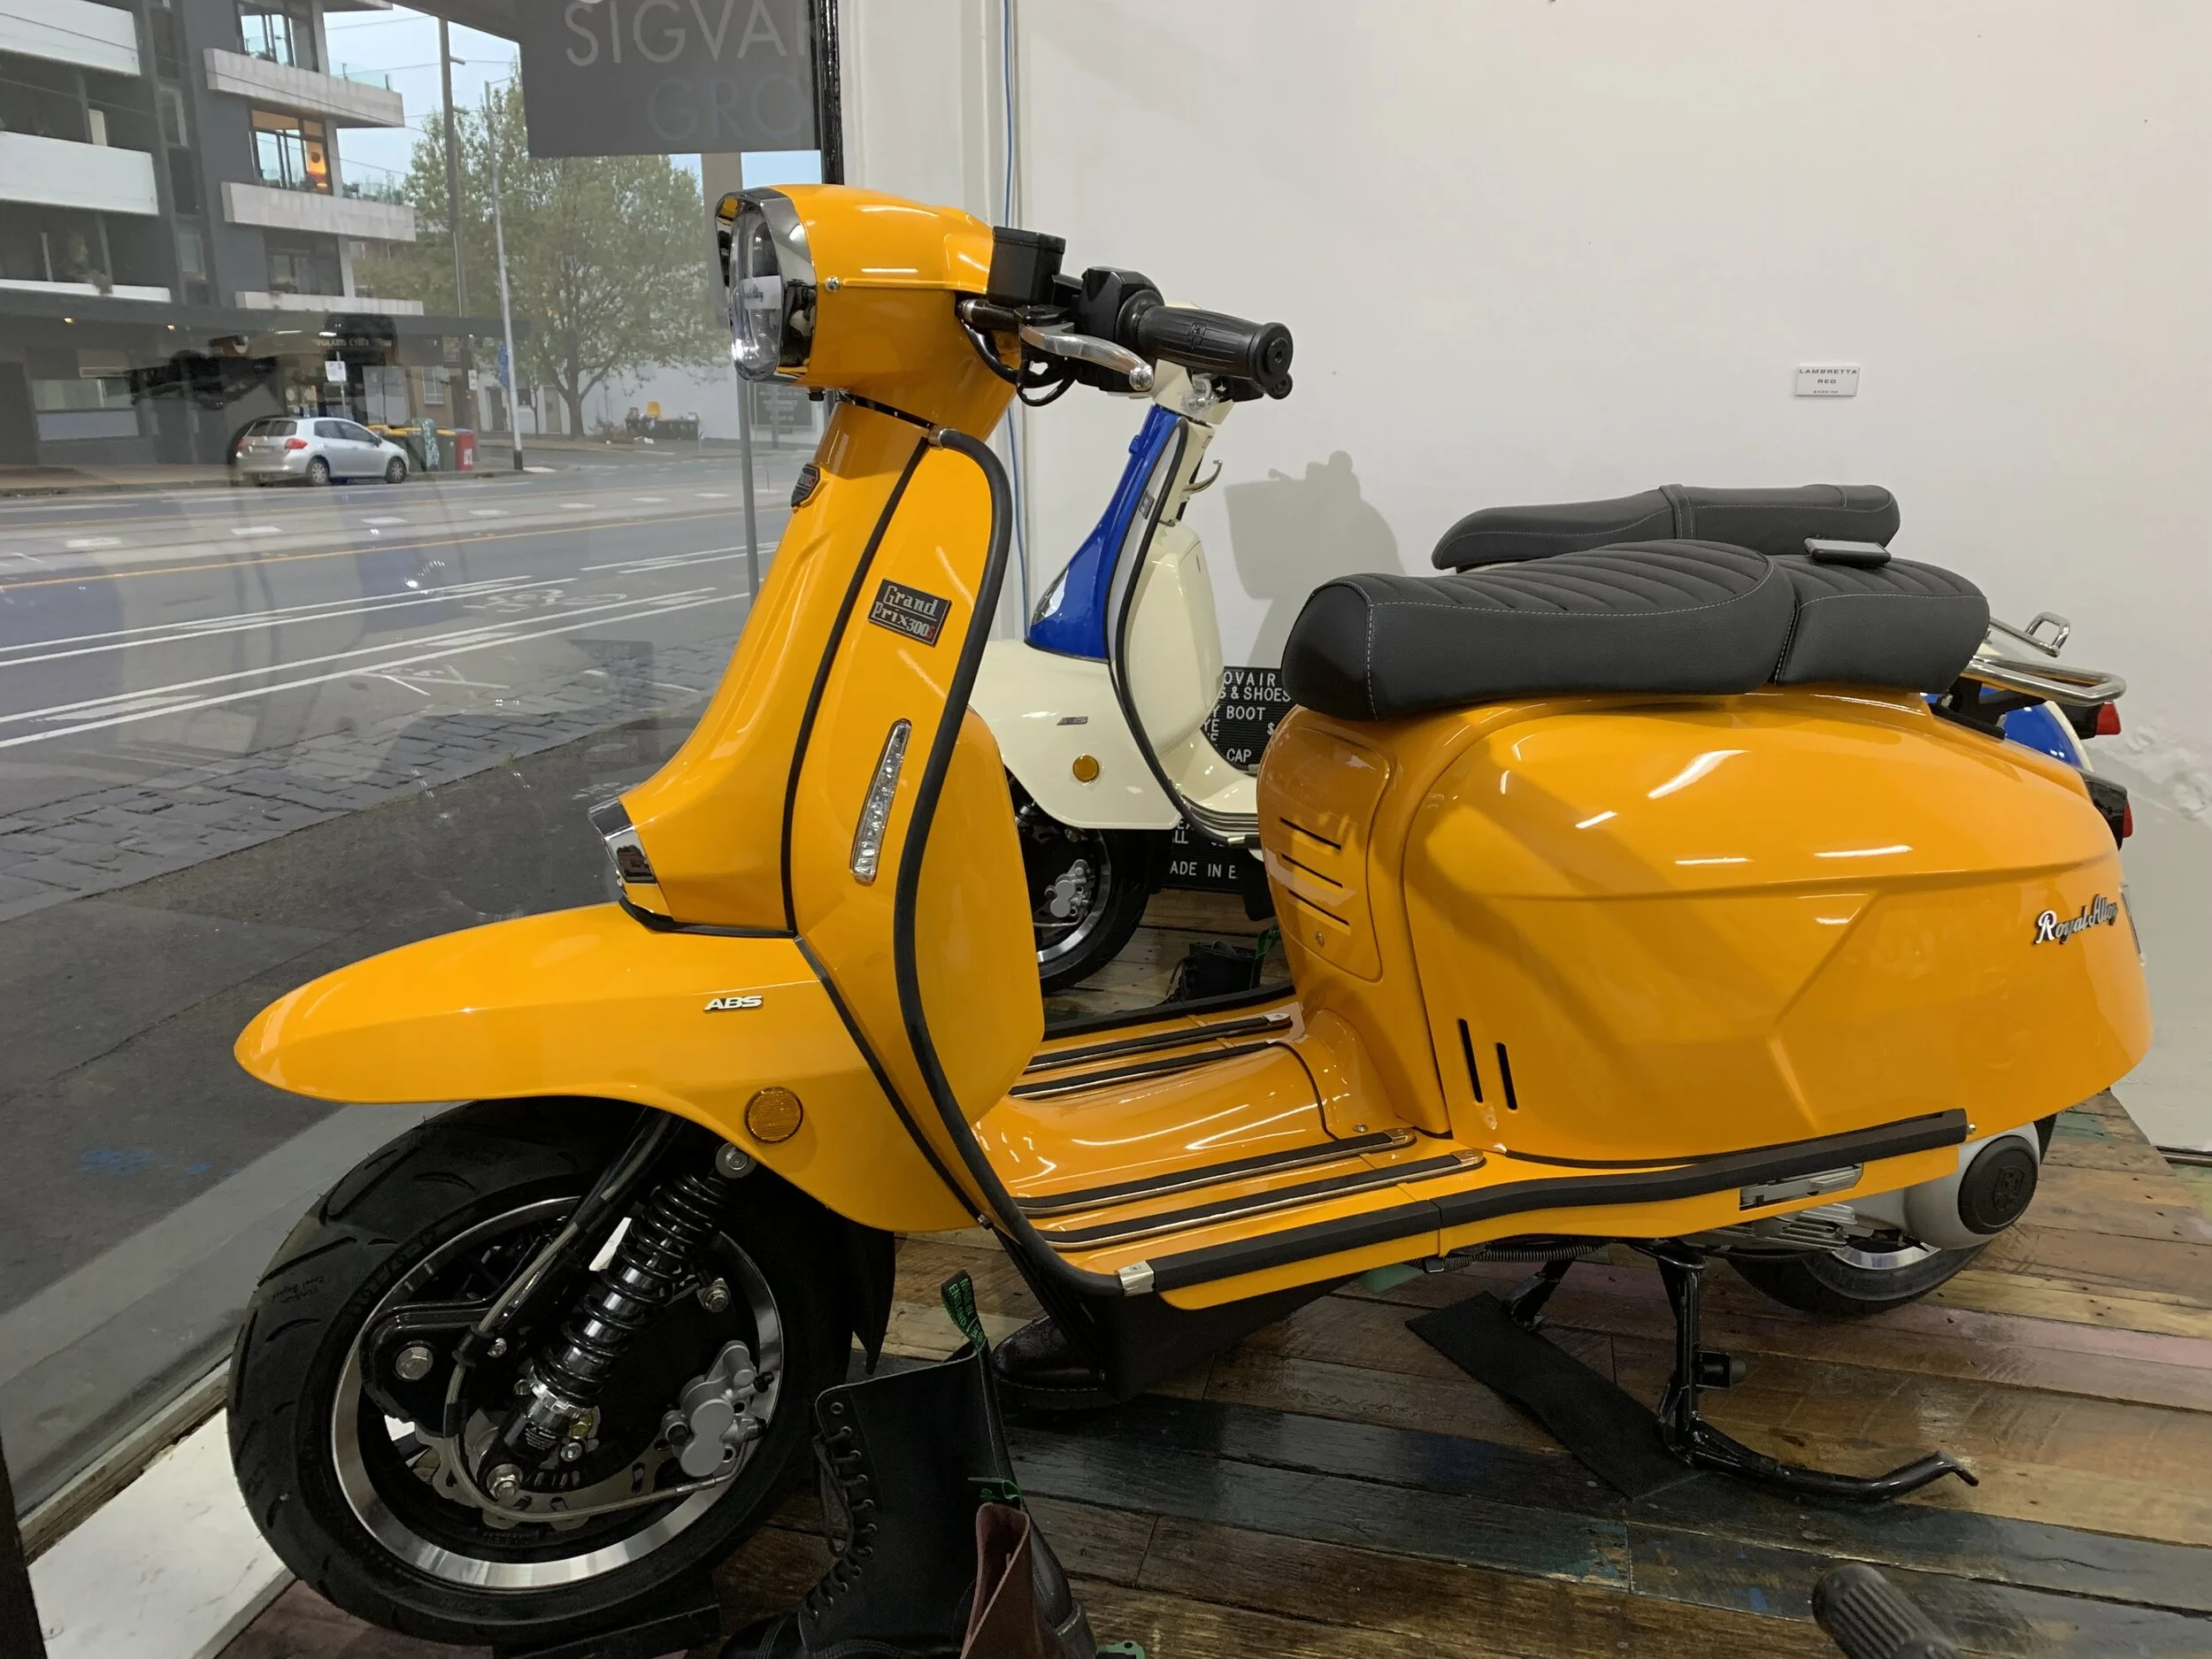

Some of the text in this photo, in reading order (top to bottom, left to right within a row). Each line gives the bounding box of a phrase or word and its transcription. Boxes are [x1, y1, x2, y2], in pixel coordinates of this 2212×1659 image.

[883, 585, 938, 618] Grand
[1231, 686, 1240, 700] &
[1226, 705, 1266, 721] BOOT
[1226, 748, 1252, 764] CAP
[1170, 860, 1197, 876] ADE
[1208, 863, 1222, 878] IN
[2033, 906, 2089, 945] Royal
[703, 995, 764, 1011] ABS
